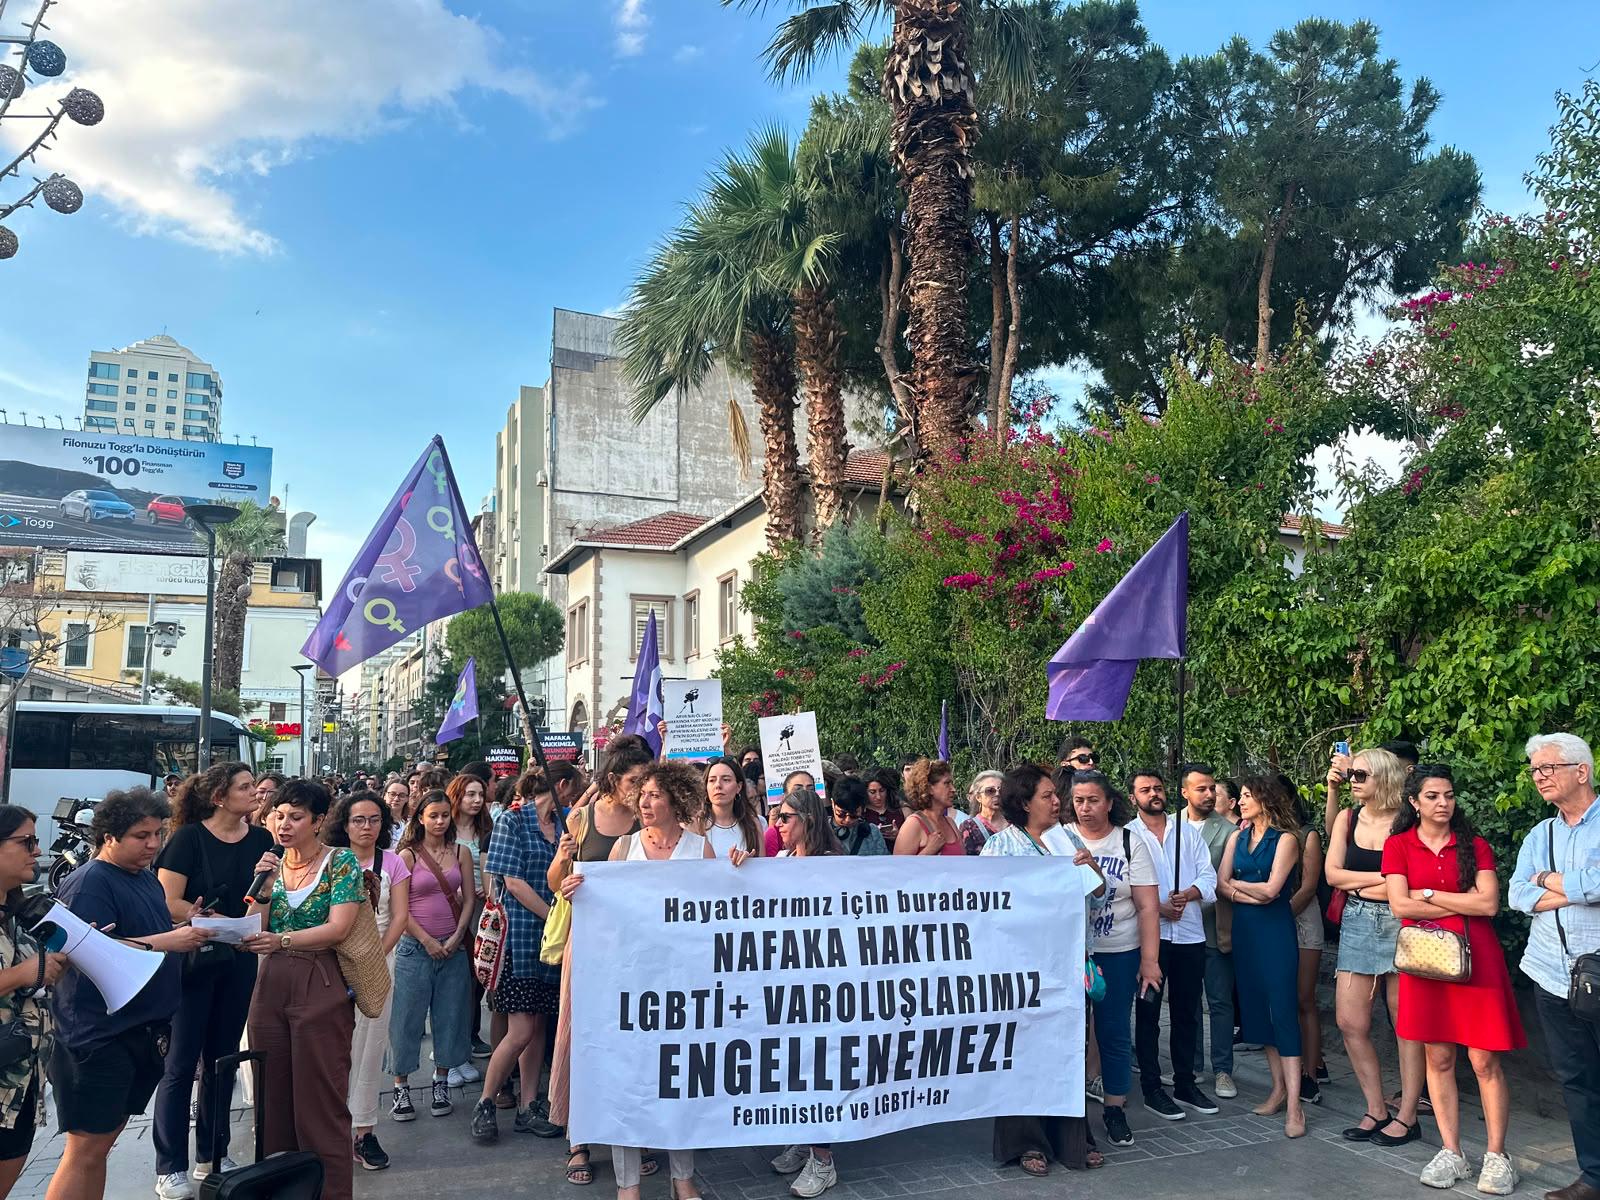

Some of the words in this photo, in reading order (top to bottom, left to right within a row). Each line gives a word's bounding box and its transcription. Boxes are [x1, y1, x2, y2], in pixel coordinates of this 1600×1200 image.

[63, 438, 106, 450] Filonuzu
[107, 441, 145, 454] Togg'la
[146, 445, 206, 458] Dönüştürün
[82, 455, 141, 477] %100
[142, 460, 173, 468] Finansman
[142, 467, 164, 475] Togg'da
[23, 516, 54, 530] Togg
[184, 576, 206, 584] kursu
[485, 755, 520, 763] HAKKIMIZA
[664, 895, 833, 924] Hayatlarımız
[841, 891, 889, 919] için
[896, 887, 1012, 913] buradayız
[713, 927, 848, 974] NAFAKA
[857, 922, 972, 966] HAKTIR
[619, 980, 749, 1032] LGBTİ+
[763, 971, 1041, 1027] VAROLUŞLARIMIZ
[658, 1021, 1018, 1100] ENGELLENEMEZ!
[733, 1102, 844, 1127] Feministler
[849, 1101, 869, 1121] ve
[874, 1086, 950, 1117] LGBTİ+lar
